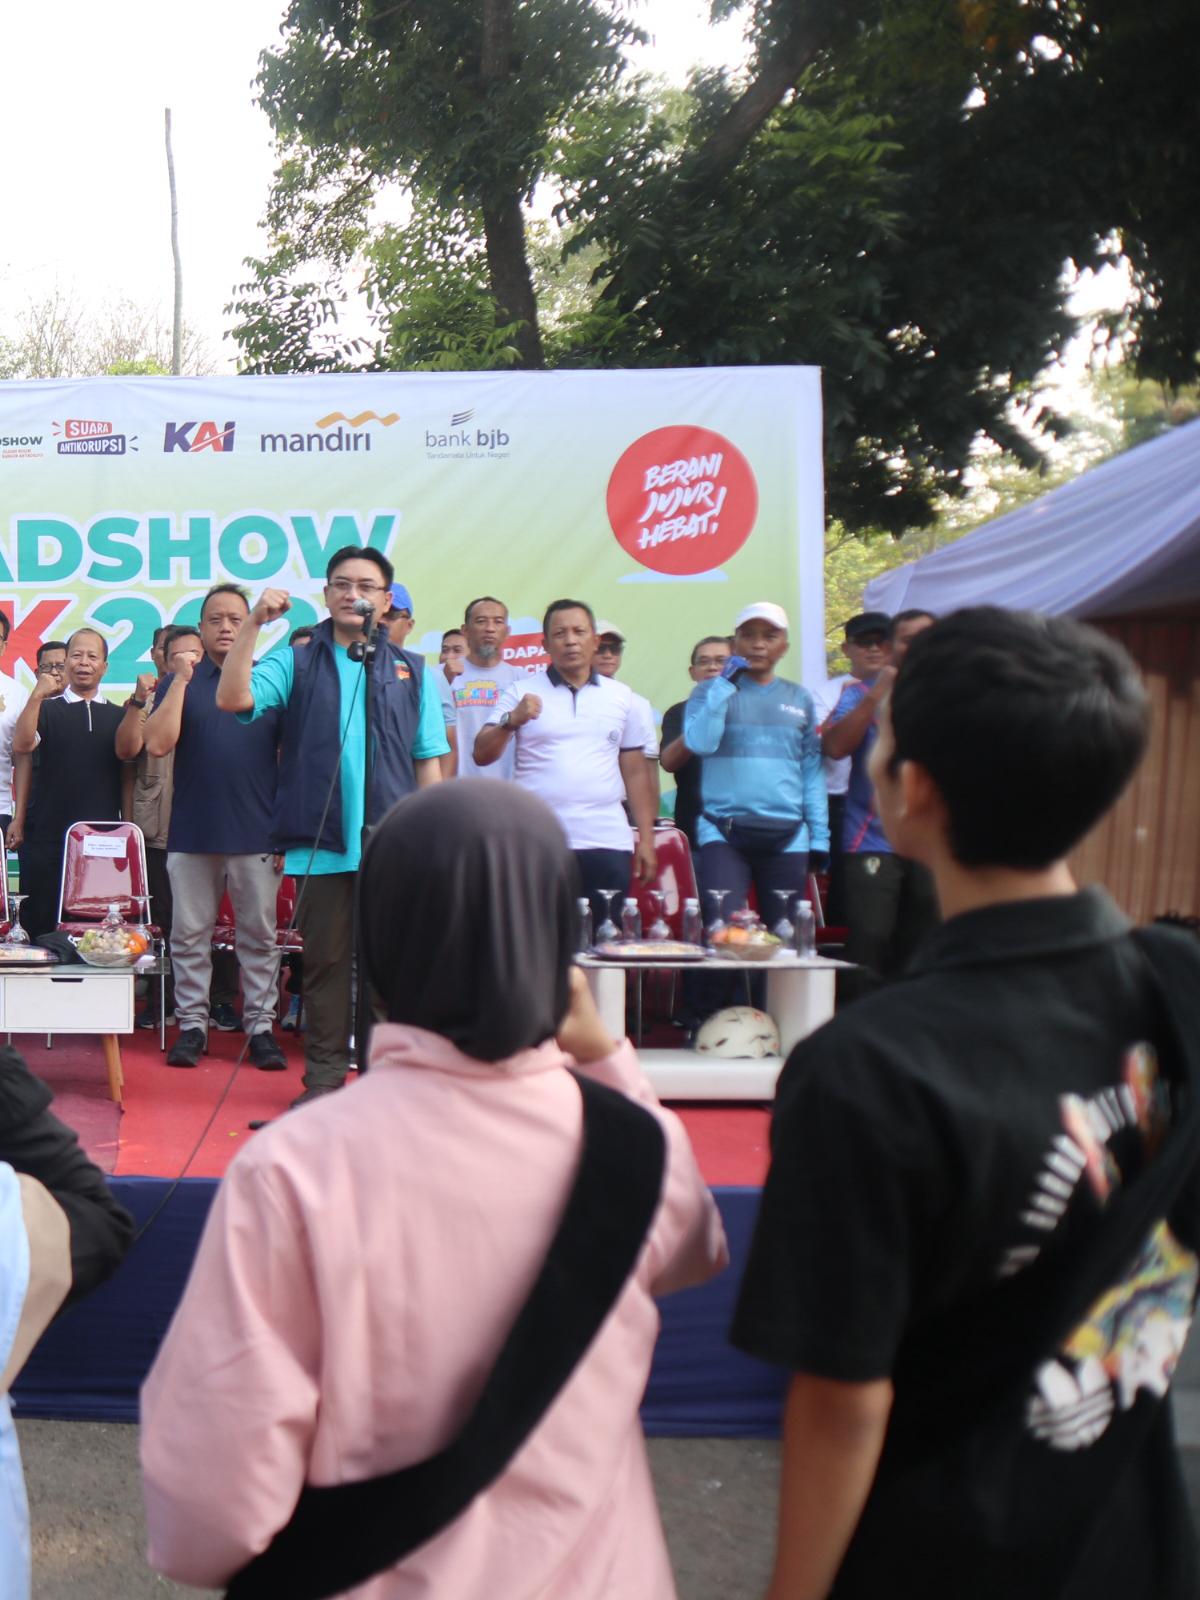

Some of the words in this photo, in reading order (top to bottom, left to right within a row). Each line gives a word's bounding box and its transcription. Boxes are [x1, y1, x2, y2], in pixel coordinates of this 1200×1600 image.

[70, 421, 109, 436] SUARA
[164, 421, 236, 452] KAI
[260, 427, 371, 452] mandiri
[425, 430, 471, 447] bank
[477, 429, 510, 449] bjb
[60, 439, 122, 453] ANTIKORUPSI
[643, 452, 723, 491] BERANI
